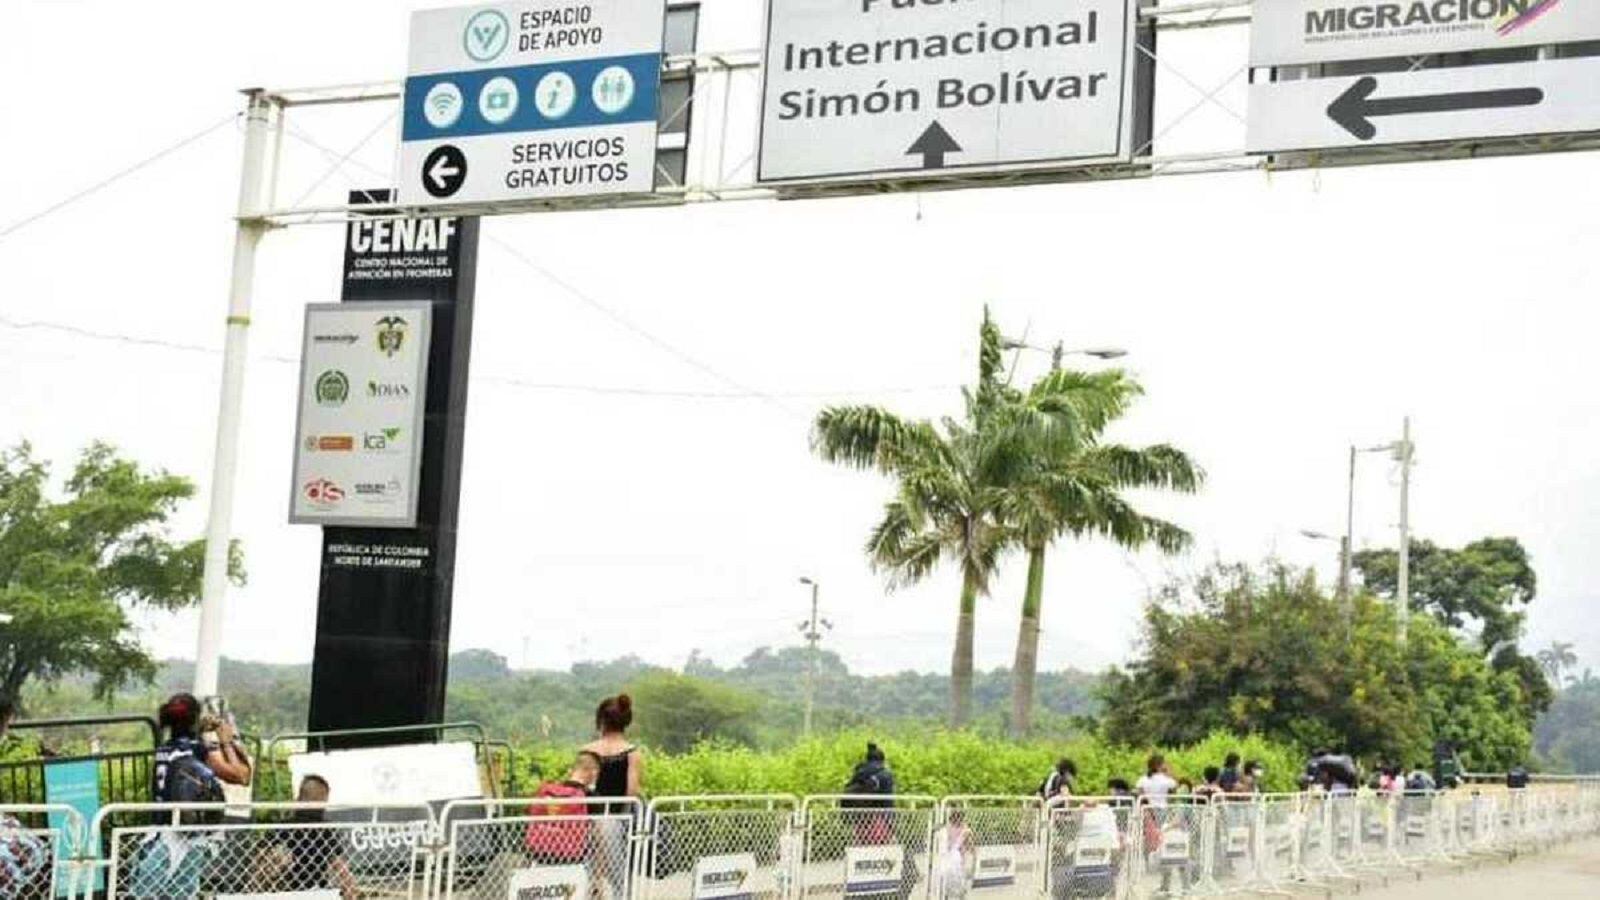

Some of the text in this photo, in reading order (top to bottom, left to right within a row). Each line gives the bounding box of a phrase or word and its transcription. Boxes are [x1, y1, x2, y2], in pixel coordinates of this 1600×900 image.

[520, 6, 592, 30] ESPACIO
[518, 27, 602, 51] DE APOYO
[784, 11, 1098, 71] Internacional
[779, 71, 1107, 120] Simón Bolívar
[511, 137, 625, 164] SERVICIOS
[505, 162, 629, 188] GRATUITOS
[351, 217, 456, 252] CENAF
